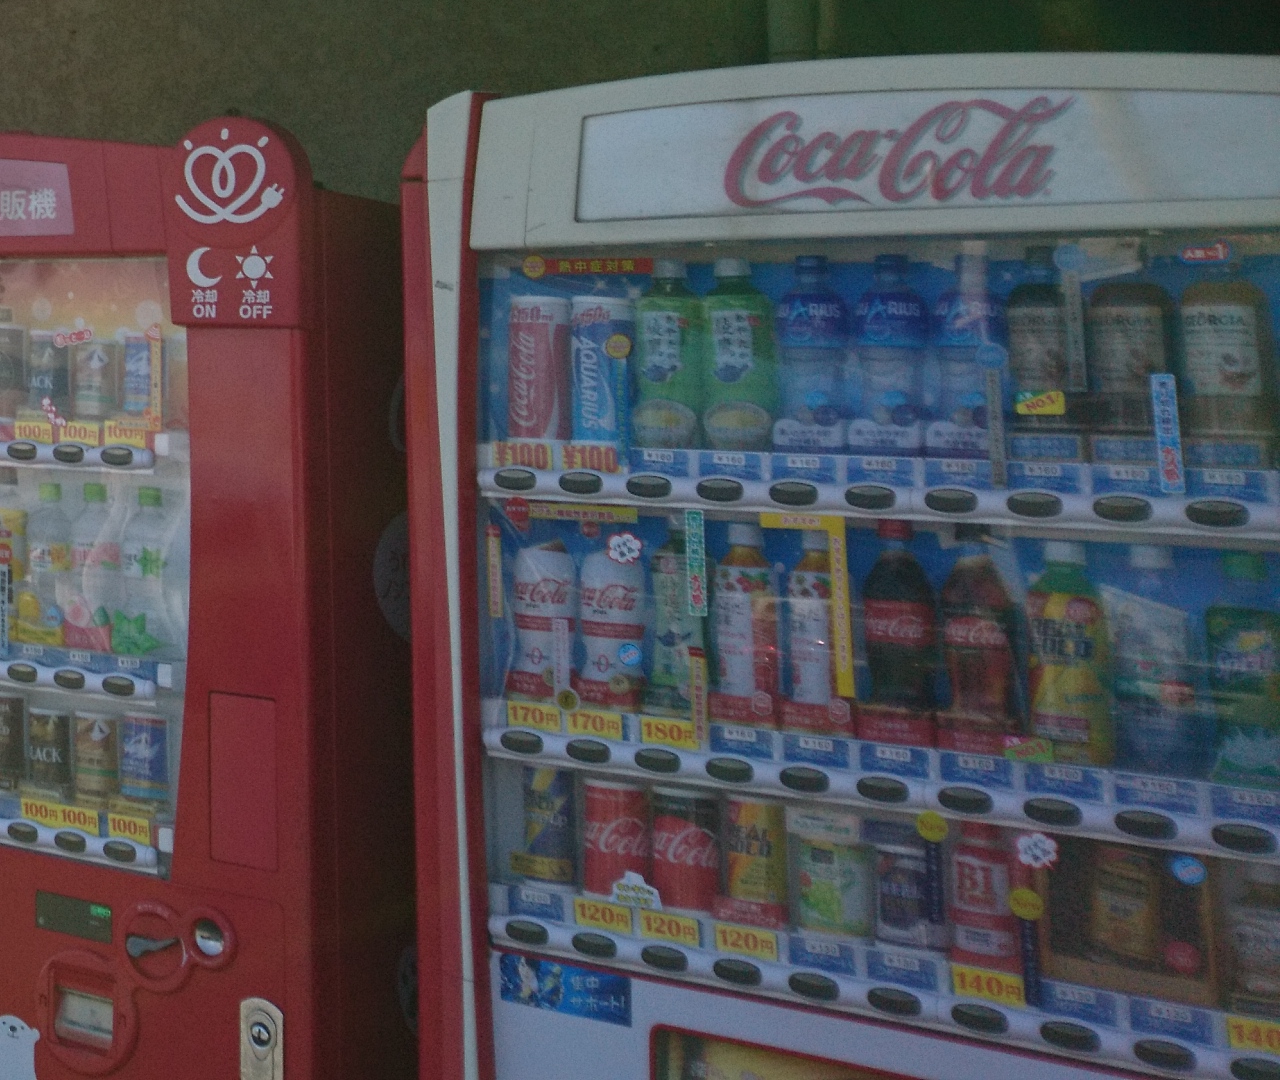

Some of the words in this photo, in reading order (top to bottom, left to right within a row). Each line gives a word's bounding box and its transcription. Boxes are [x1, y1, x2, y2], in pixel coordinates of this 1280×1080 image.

[723, 96, 1076, 208] Coca-Cola
[192, 304, 217, 318] ON
[239, 305, 273, 319] OFF
[510, 705, 559, 727] 170円
[570, 711, 621, 735] 170円
[24, 801, 59, 820] 100円
[62, 809, 97, 828] 100円
[111, 817, 148, 838] 100円
[579, 903, 629, 928] 120円
[644, 914, 697, 940] 120円
[719, 927, 774, 954] 120円
[956, 971, 1021, 998] 140円
